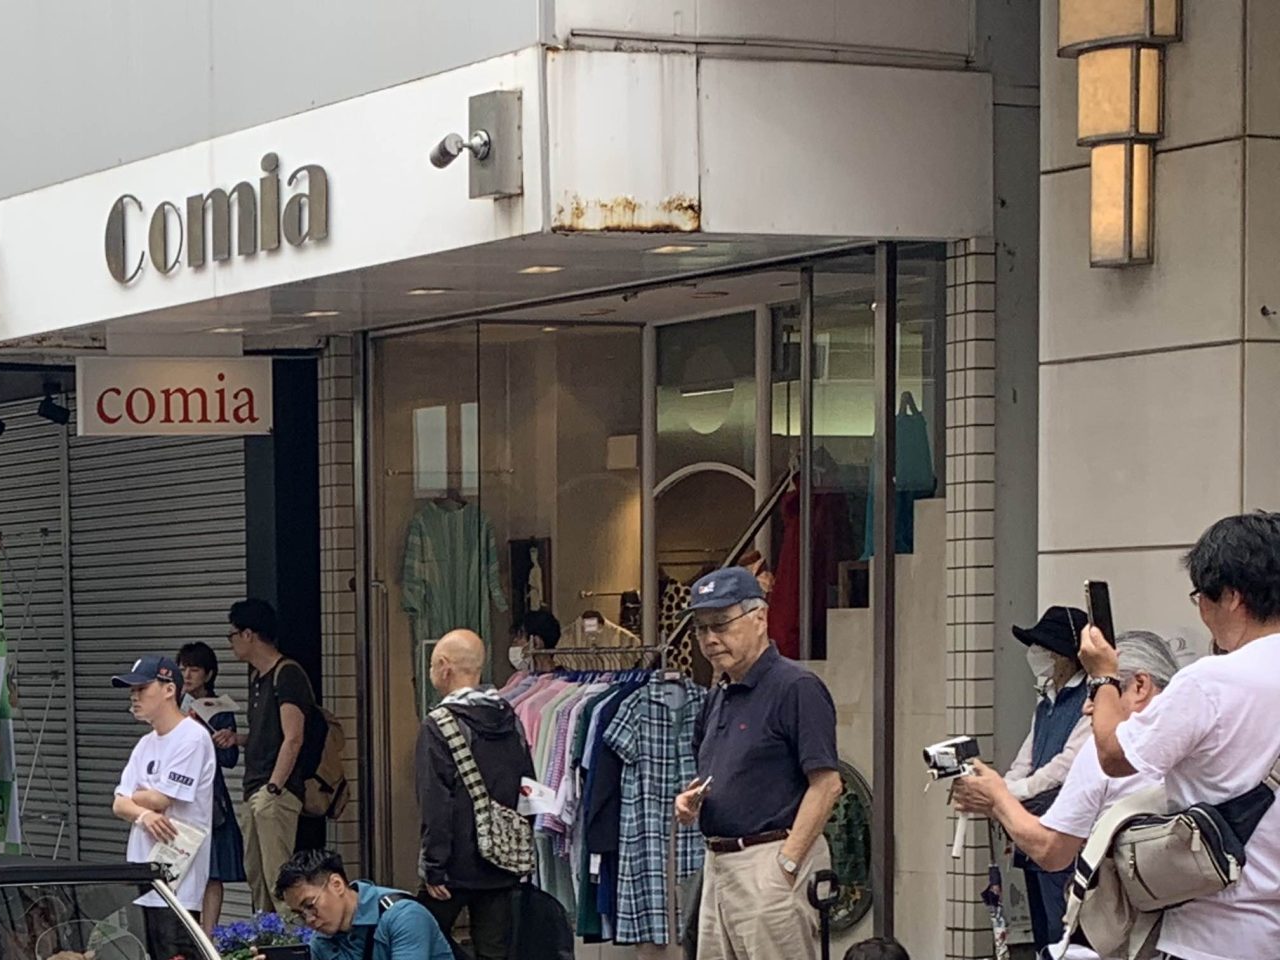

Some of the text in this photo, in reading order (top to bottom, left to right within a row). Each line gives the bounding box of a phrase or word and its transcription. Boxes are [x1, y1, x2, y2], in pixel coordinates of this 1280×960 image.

[104, 152, 329, 284] Comia
[96, 372, 260, 425] comia
[169, 772, 194, 786] STAFF
